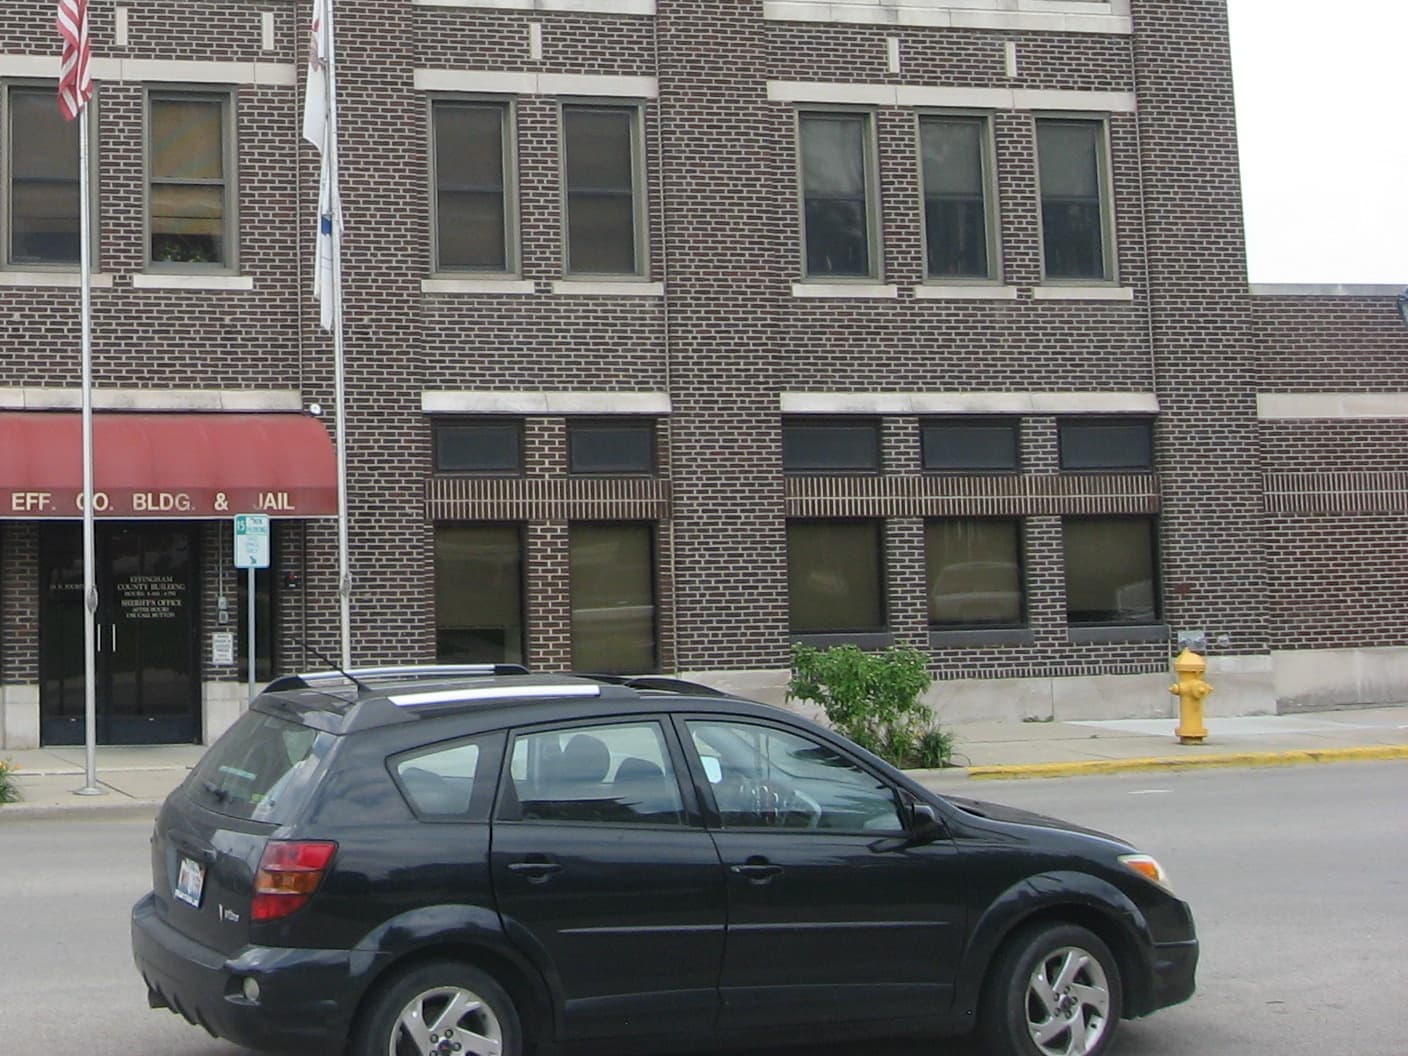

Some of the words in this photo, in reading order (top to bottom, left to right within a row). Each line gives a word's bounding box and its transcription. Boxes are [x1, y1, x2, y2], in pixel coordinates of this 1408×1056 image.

[11, 492, 57, 511] EFF.
[132, 492, 196, 511] BLDG.
[214, 492, 229, 511] &
[252, 492, 295, 511] JAIL
[157, 599, 182, 607] OFFICE
